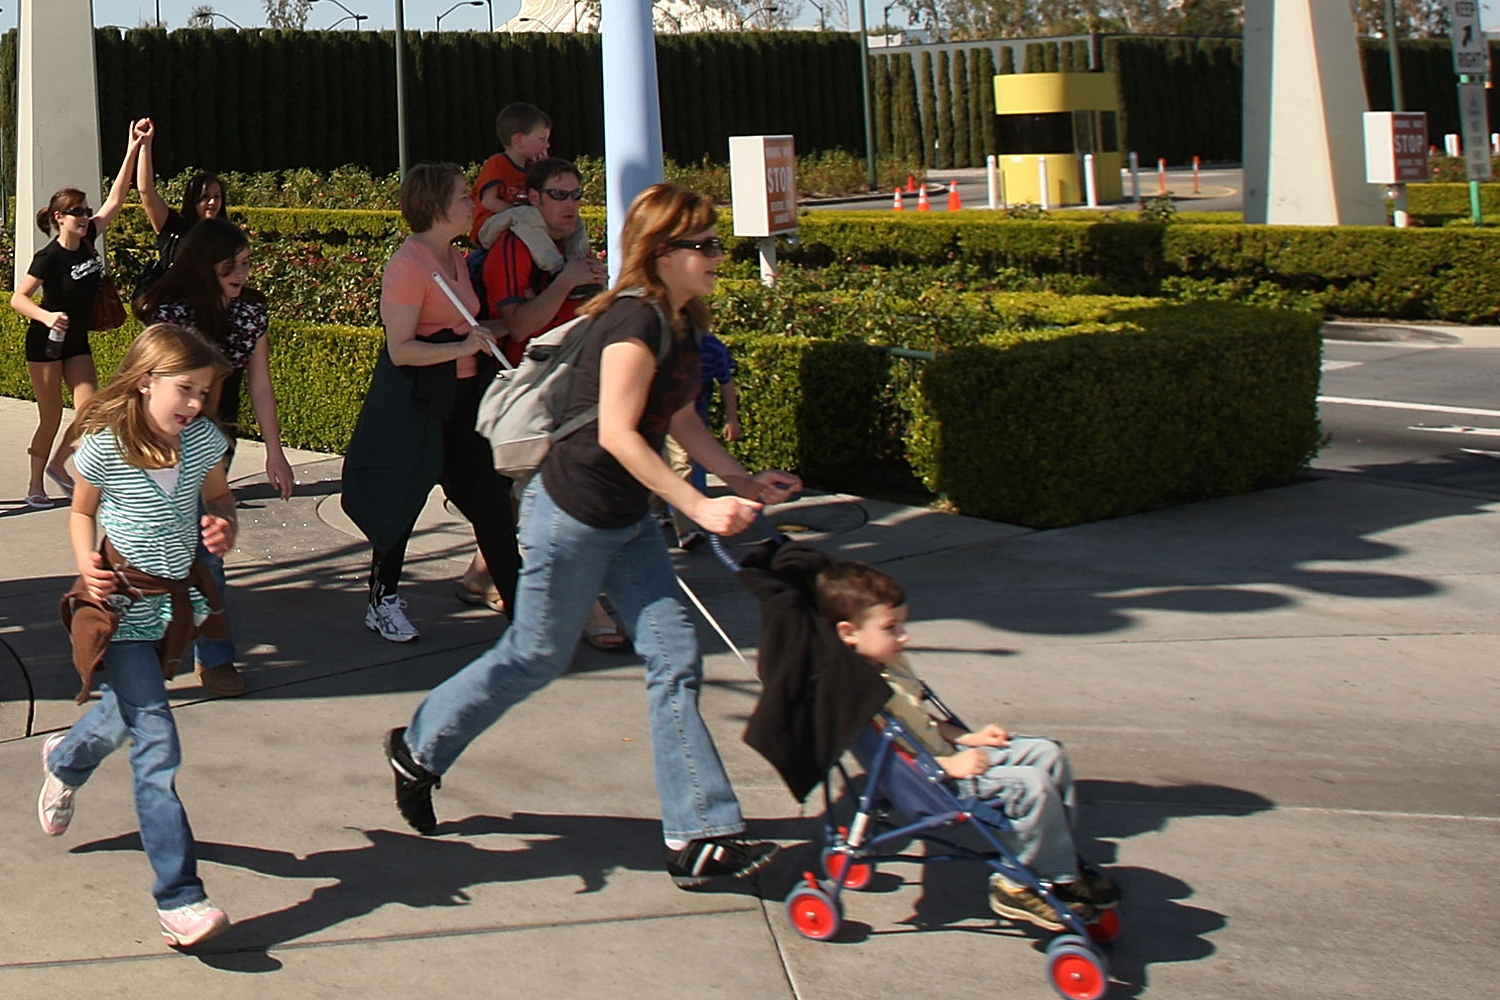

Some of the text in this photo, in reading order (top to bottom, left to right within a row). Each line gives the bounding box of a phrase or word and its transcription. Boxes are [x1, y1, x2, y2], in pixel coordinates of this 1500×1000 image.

[1454, 1, 1475, 17] KEEP
[1395, 134, 1424, 153] STOP
[767, 166, 793, 194] STOP
